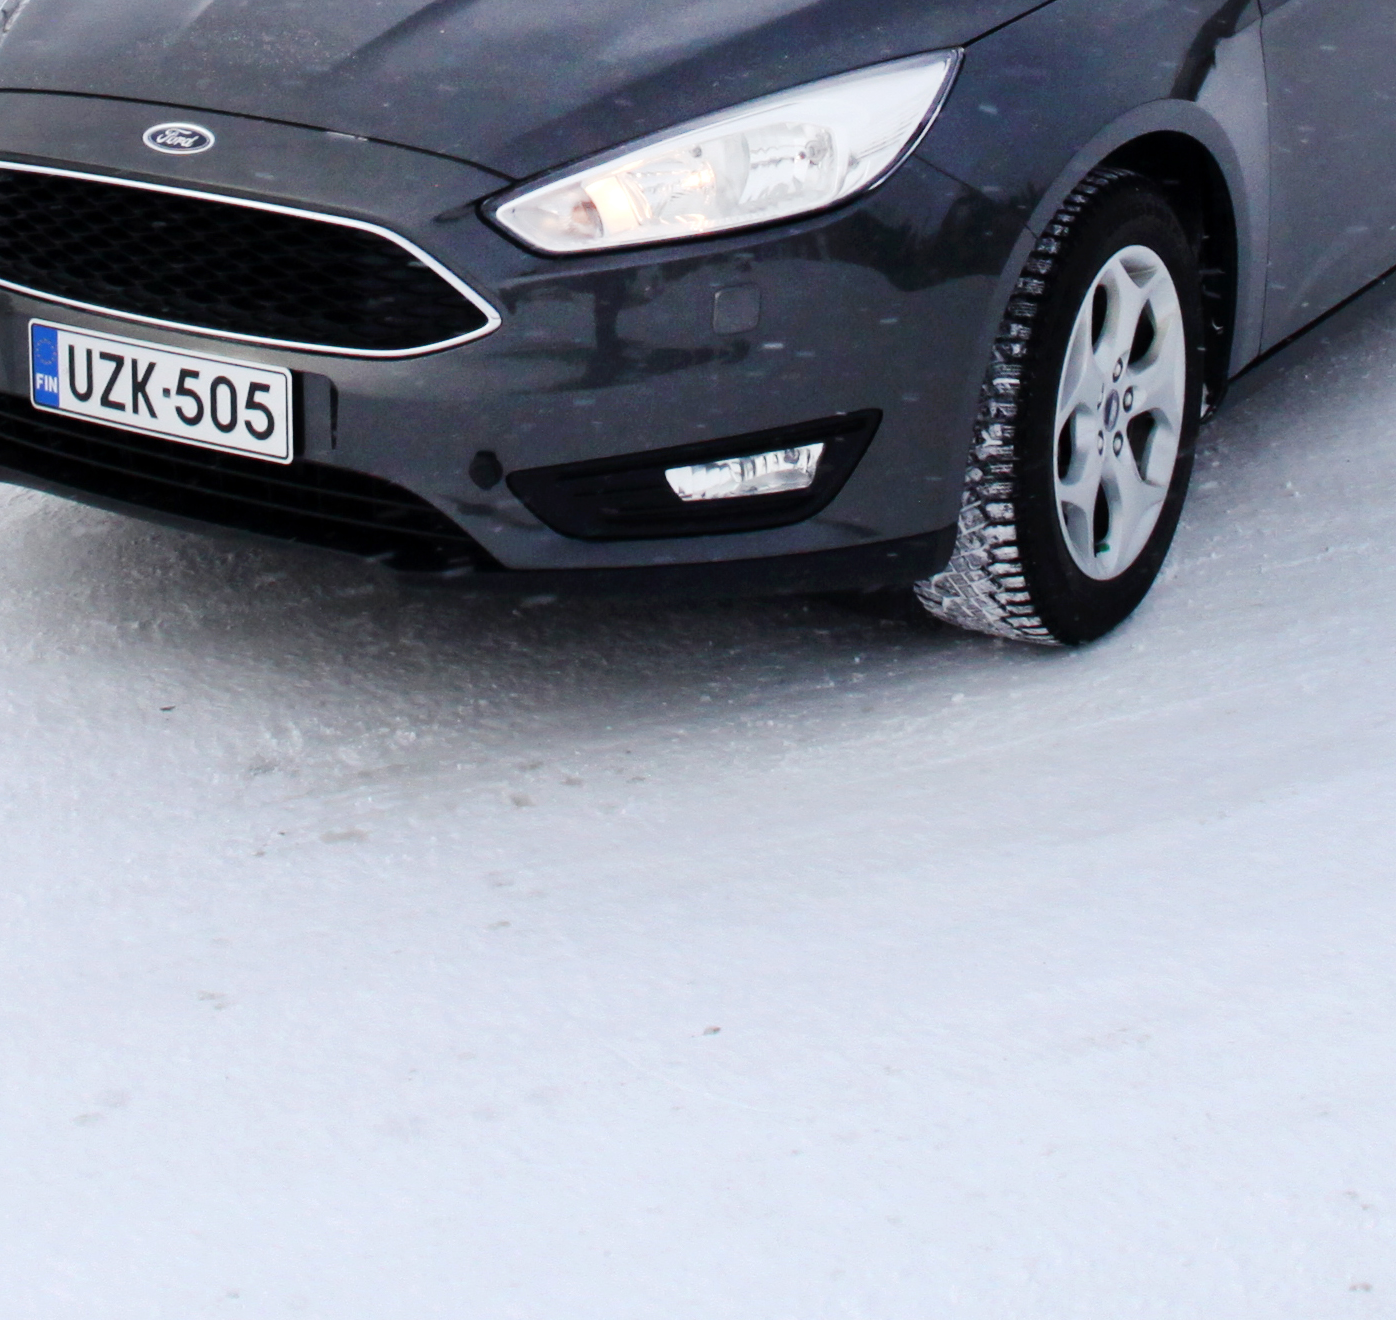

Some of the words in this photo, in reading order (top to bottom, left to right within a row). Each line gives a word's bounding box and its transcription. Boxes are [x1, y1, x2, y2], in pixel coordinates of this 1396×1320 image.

[156, 128, 200, 148] Ford
[35, 372, 58, 394] FIN
[68, 344, 275, 441] UZK-505
